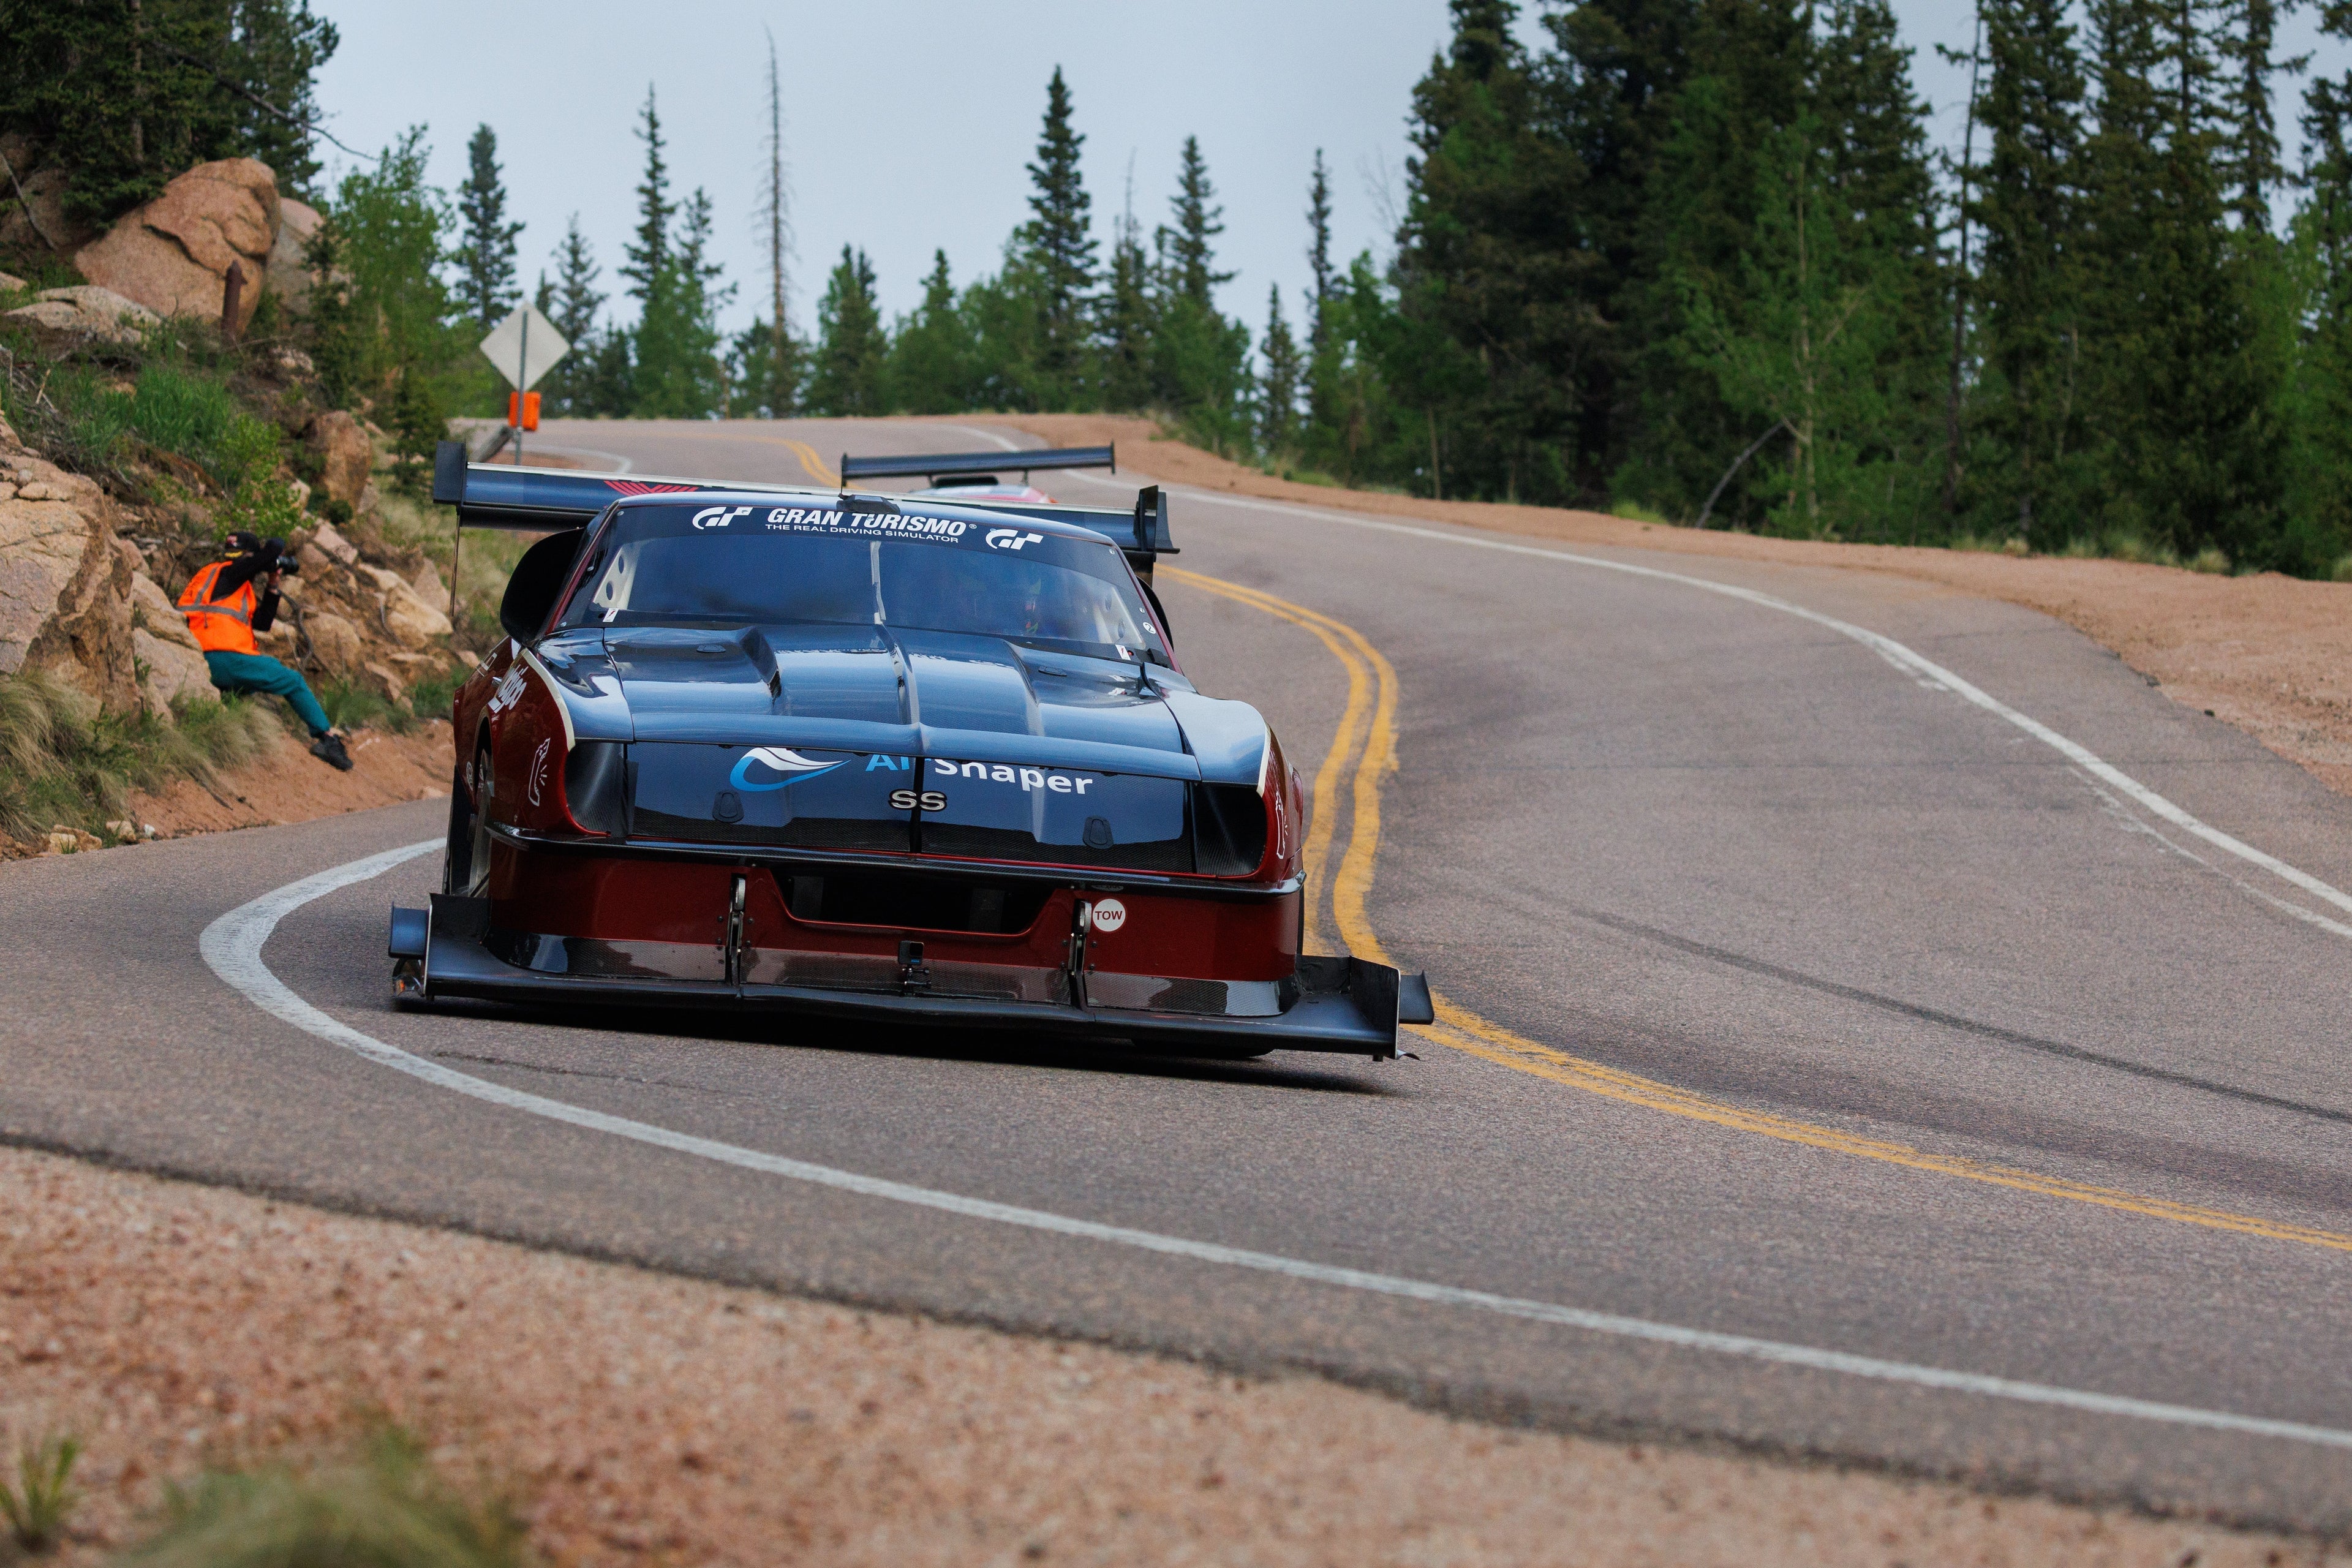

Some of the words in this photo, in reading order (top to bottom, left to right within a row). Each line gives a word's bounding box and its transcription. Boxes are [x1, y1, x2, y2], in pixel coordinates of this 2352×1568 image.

[767, 508, 844, 526] GRAN
[830, 527, 882, 536] DRIVING
[885, 530, 959, 543] SIMULATOR
[891, 790, 945, 810] SS
[1095, 910, 1123, 921] TOW
